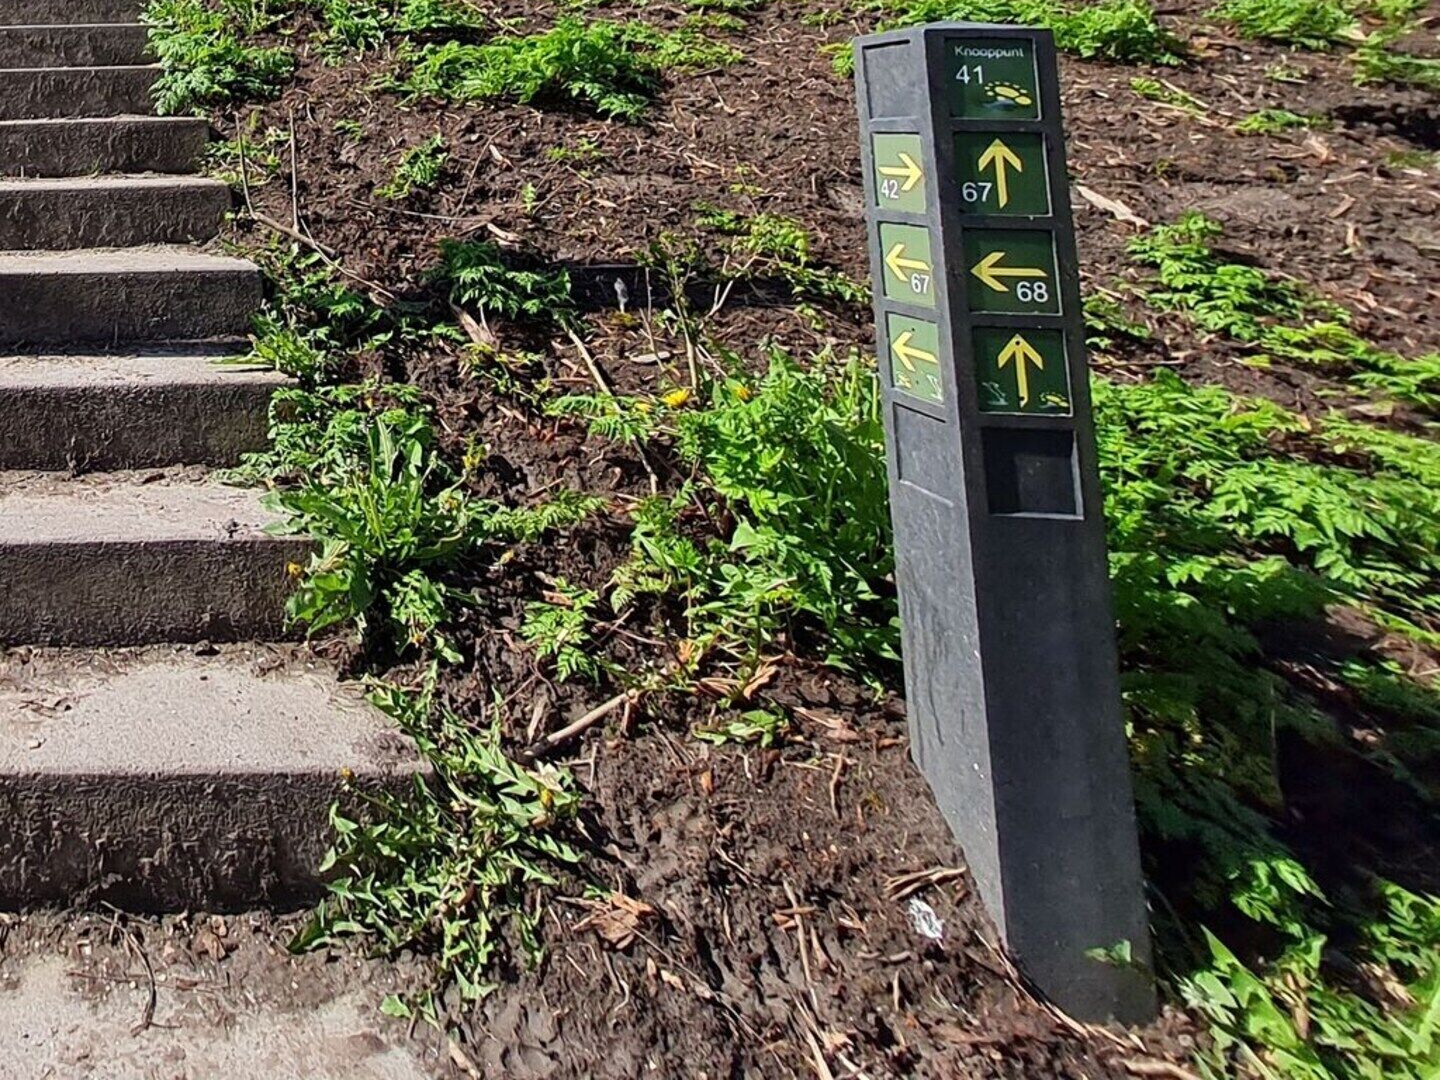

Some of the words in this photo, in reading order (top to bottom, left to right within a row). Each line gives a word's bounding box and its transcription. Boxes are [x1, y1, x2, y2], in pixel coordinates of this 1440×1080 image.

[955, 45, 1024, 58] Knooppunt
[956, 65, 983, 84] 41
[881, 180, 899, 200] 42
[962, 182, 992, 202] 67
[911, 274, 930, 294] 67
[1017, 281, 1048, 302] 68
